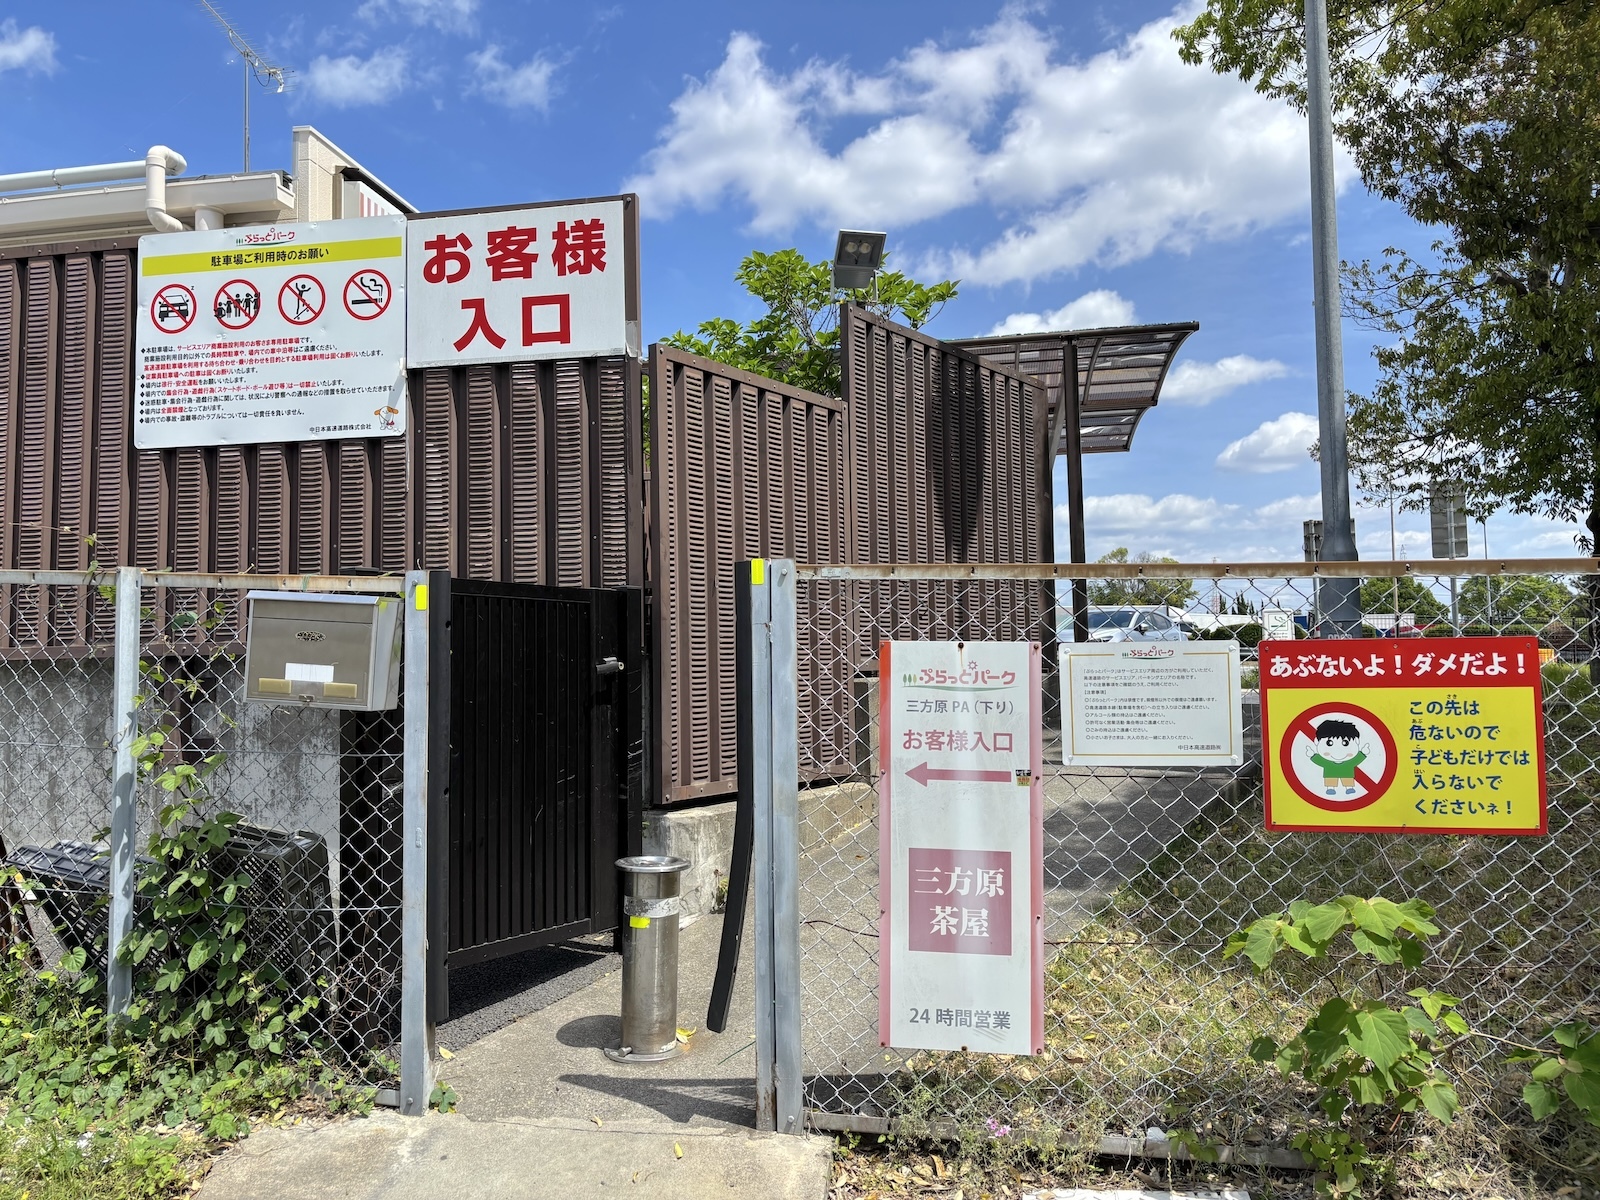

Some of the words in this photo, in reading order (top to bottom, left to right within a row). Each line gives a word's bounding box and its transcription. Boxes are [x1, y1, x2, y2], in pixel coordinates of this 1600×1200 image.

[244, 230, 296, 244] ぷらっとパーク
[211, 247, 330, 267] 駐車場ご利用時のお願い
[423, 219, 607, 284] お客様
[453, 293, 571, 353] 入口
[1129, 648, 1175, 658] ぷらっとパーク
[919, 668, 1016, 685] ぷらっとパーク
[906, 699, 948, 714] 三方原
[1409, 699, 1480, 716] この先は
[902, 729, 1013, 753] お客様入口
[1409, 724, 1500, 741] 危ないので
[1409, 749, 1530, 766] 子どもだけでは
[1412, 774, 1503, 791] 入らないで
[914, 866, 1005, 898] 三方原
[929, 905, 990, 938] 茶屋
